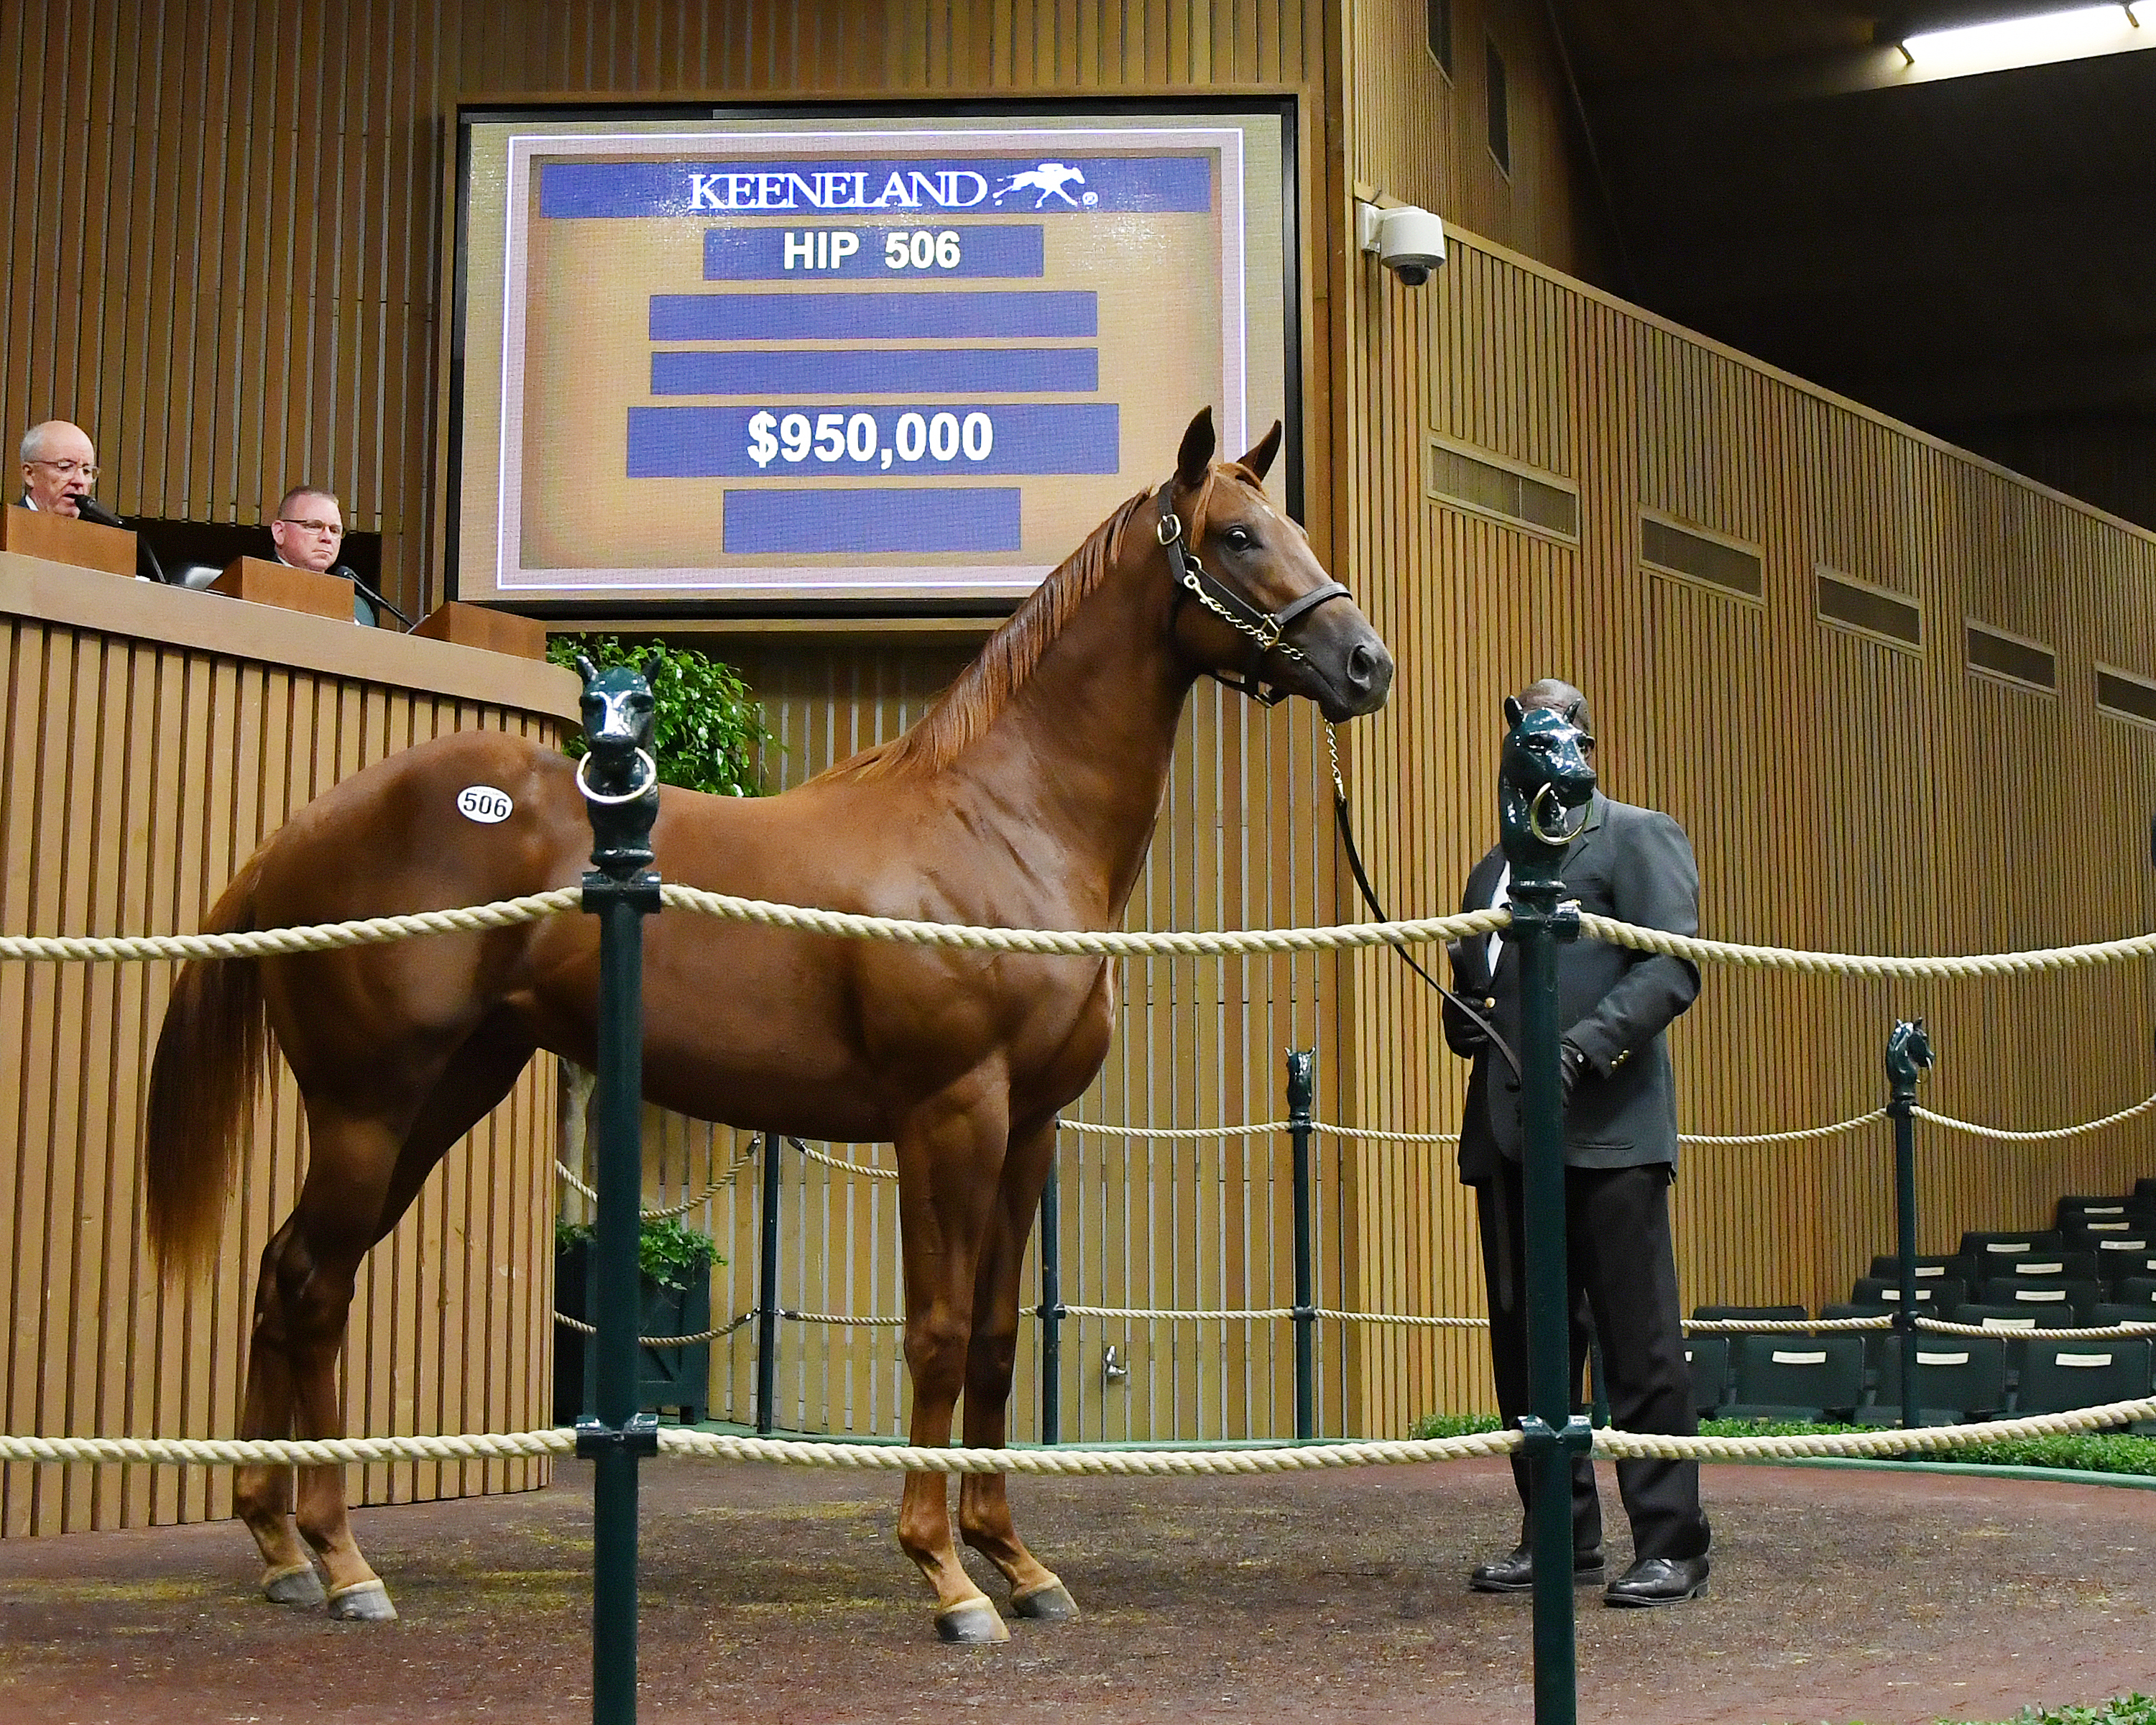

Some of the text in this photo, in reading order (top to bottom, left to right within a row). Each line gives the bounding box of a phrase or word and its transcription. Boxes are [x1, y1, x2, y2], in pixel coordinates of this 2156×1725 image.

[688, 171, 988, 211] KEENELAND
[784, 230, 961, 270] HIP 506
[747, 410, 993, 470] $950,000
[463, 792, 507, 817] 506
